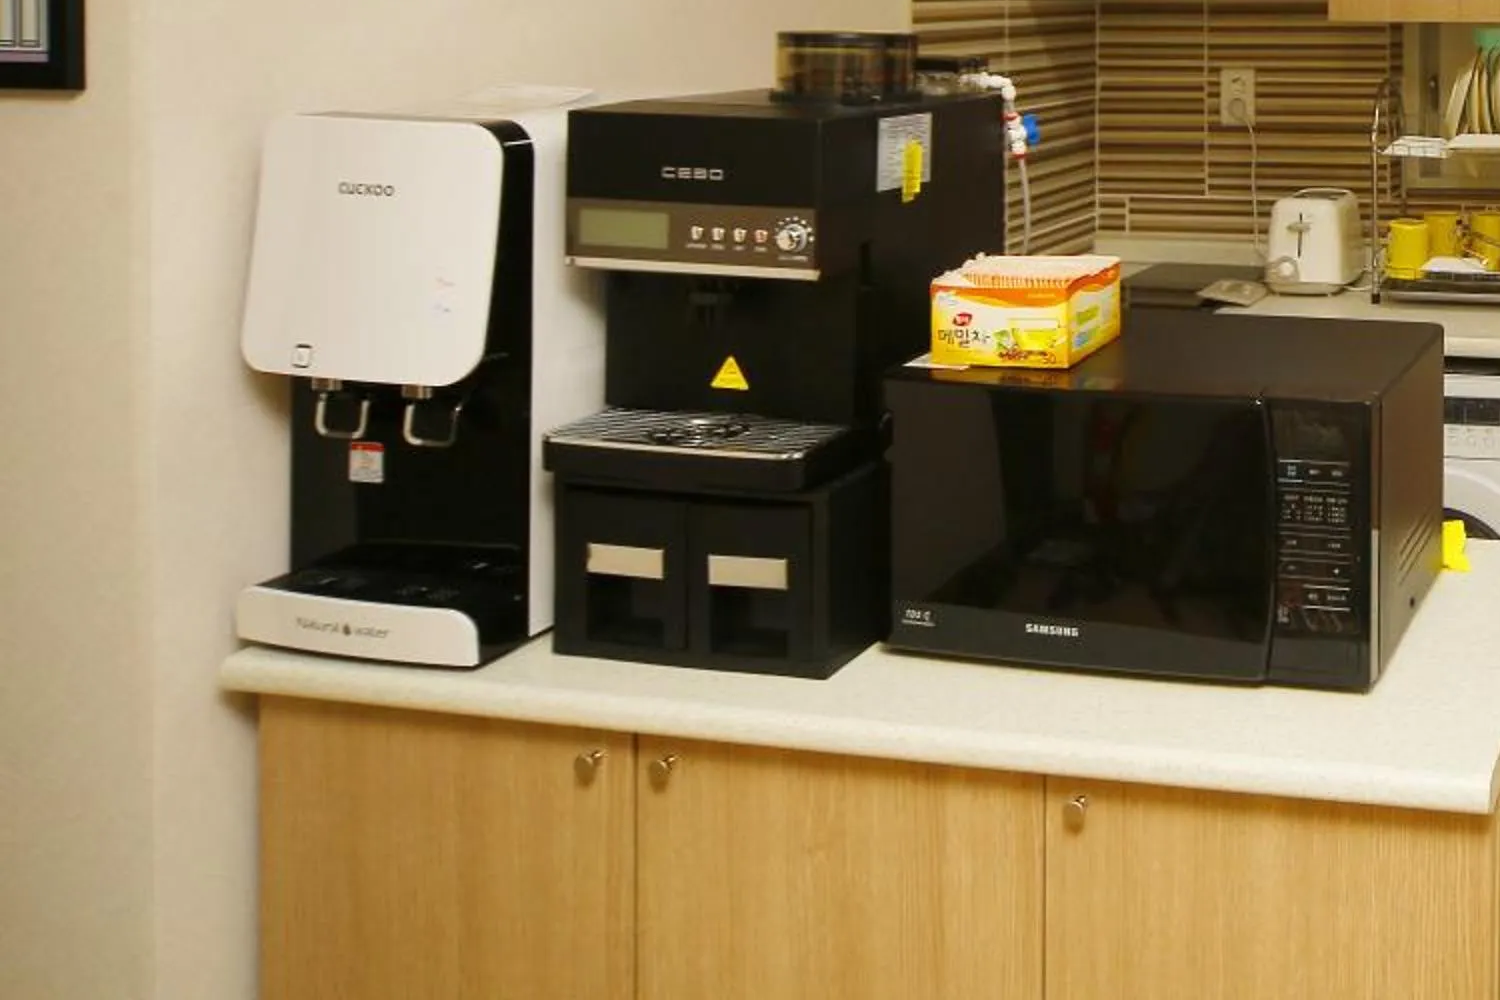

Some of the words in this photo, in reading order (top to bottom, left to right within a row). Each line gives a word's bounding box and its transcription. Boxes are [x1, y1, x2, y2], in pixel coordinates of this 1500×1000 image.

[338, 181, 396, 197] CUCKOO
[937, 329, 991, 349] 메밀차
[1025, 623, 1079, 637] SAMSUNG
